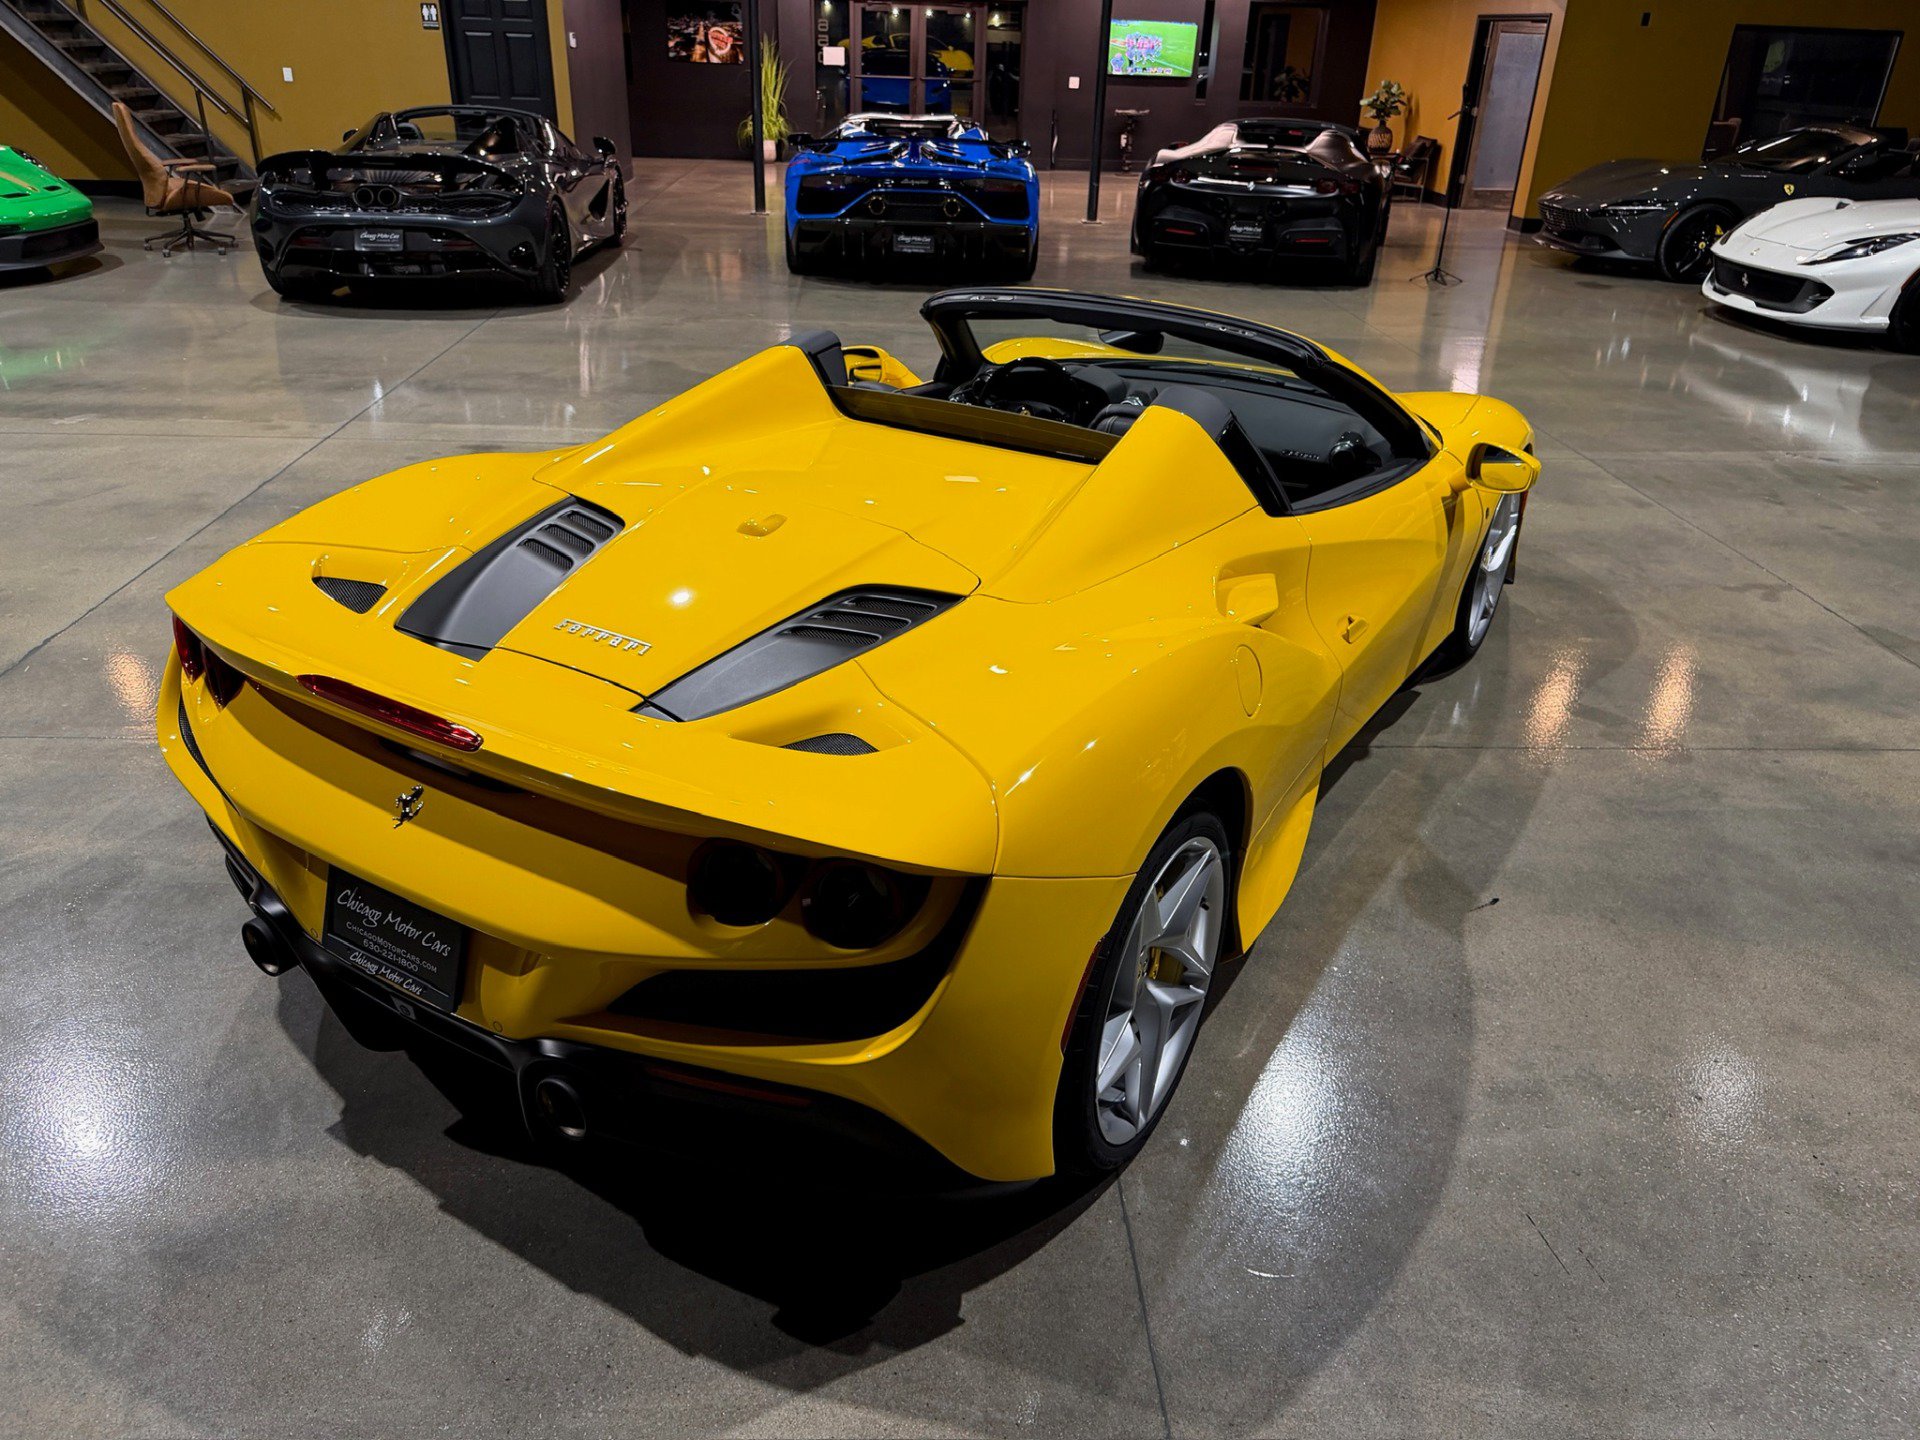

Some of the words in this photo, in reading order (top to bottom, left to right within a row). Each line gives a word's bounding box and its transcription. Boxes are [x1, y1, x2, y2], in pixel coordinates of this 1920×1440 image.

[554, 618, 652, 656] Ferrari
[336, 887, 382, 927] Chicago
[383, 911, 422, 940] Motor
[421, 931, 451, 957] Cars
[349, 951, 379, 975] Chicago
[380, 966, 402, 985] Motor
[402, 979, 422, 996] Cars
[363, 938, 419, 972] 630-221-1800
